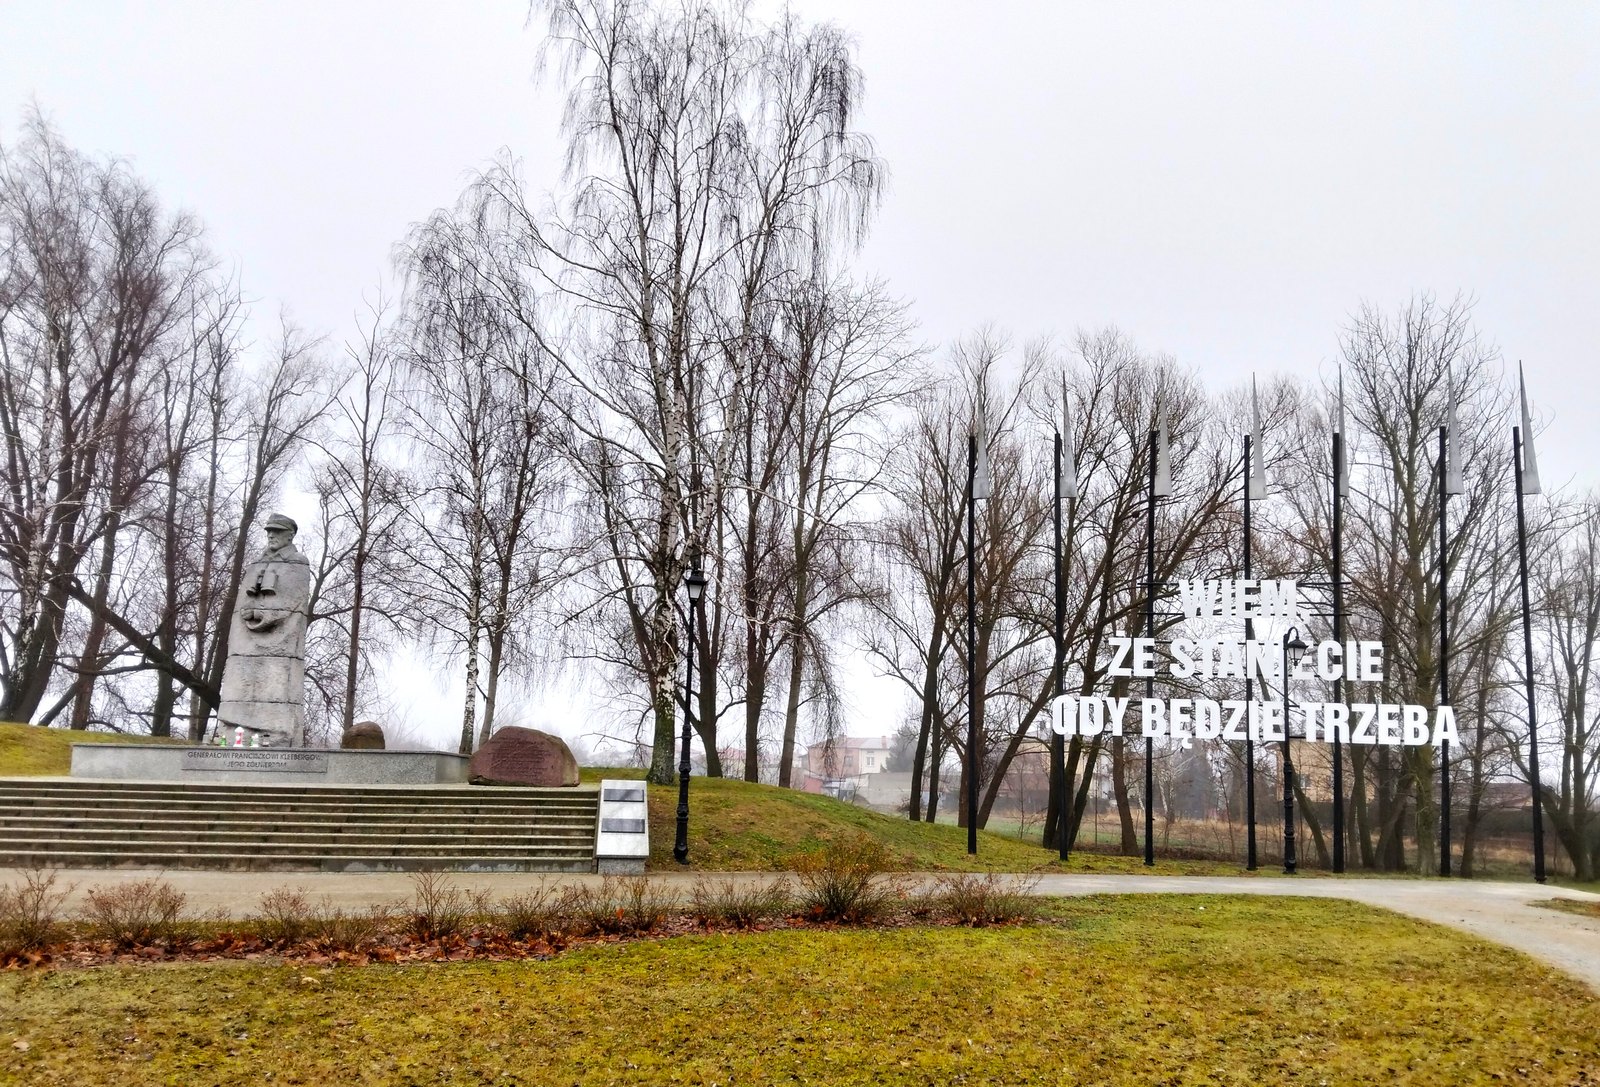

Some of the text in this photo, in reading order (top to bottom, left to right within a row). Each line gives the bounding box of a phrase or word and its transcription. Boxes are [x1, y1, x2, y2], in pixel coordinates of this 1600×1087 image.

[1108, 631, 1155, 677] ŻE
[1052, 695, 1461, 749] GDY BĘDZIE TRZEBA
